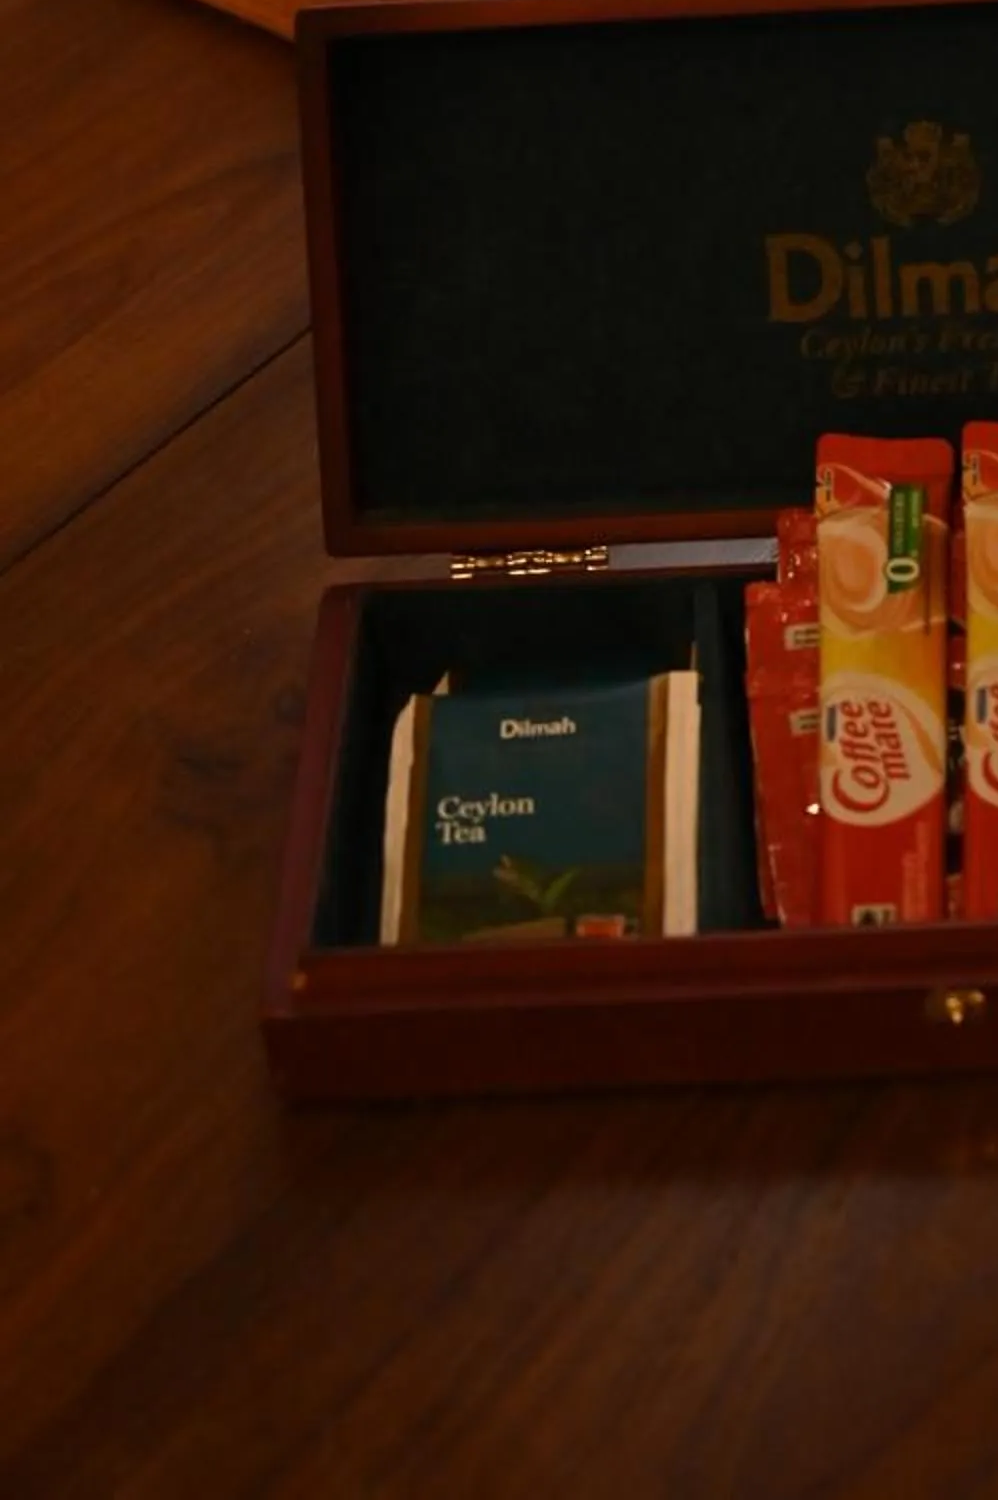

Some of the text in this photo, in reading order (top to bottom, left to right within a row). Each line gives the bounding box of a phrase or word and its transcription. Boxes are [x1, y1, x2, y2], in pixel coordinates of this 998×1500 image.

[500, 717, 577, 740] Dilmah
[868, 701, 911, 781] mate
[832, 700, 890, 812] Coffee
[437, 793, 536, 823] Ceylon
[435, 822, 487, 844] Tea
